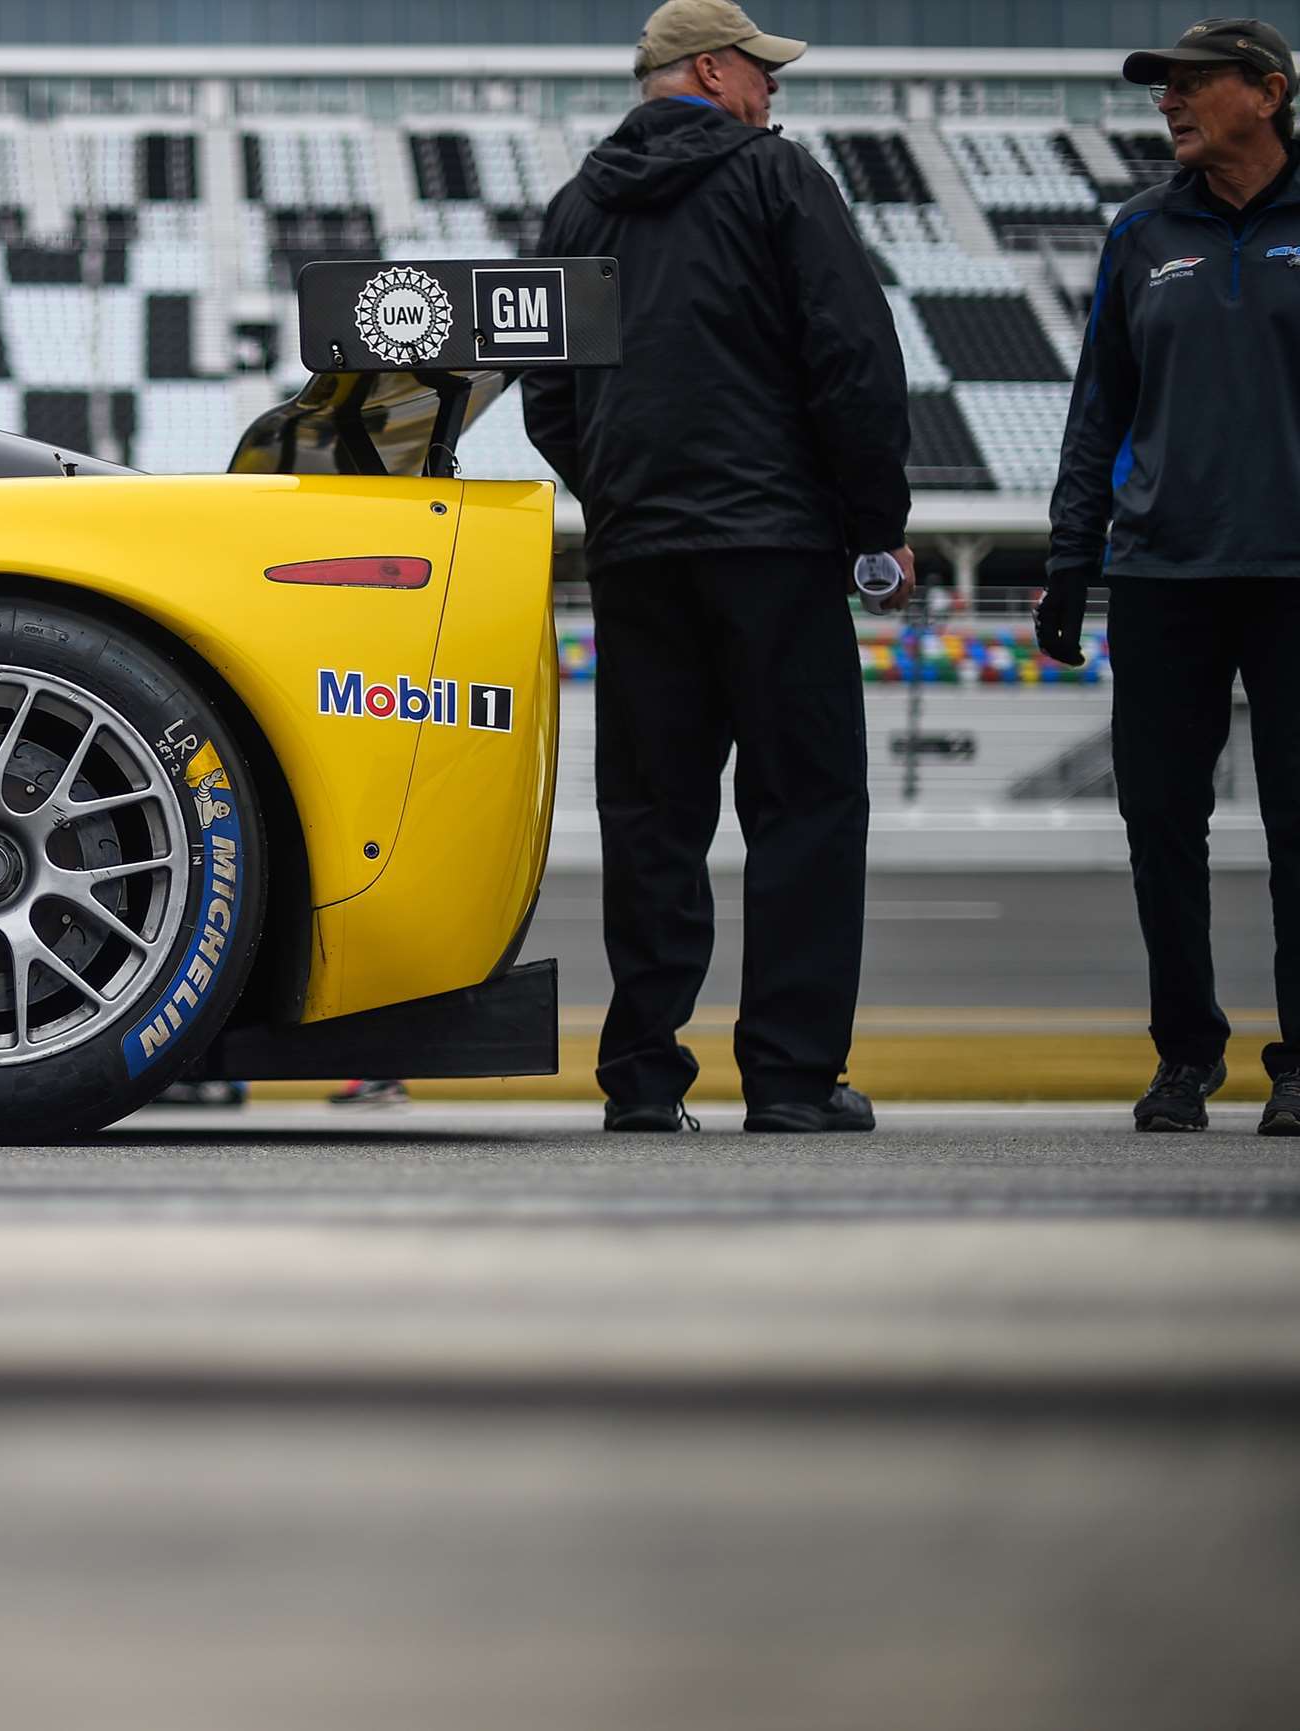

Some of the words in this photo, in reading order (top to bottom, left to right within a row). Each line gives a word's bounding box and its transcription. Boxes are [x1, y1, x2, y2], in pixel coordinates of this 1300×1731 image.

[383, 306, 424, 326] UAW
[491, 287, 548, 329] GM
[317, 668, 458, 728] Mobil
[482, 689, 496, 727] 1
[155, 739, 176, 762] SET
[139, 834, 237, 1059] MICHELIN
